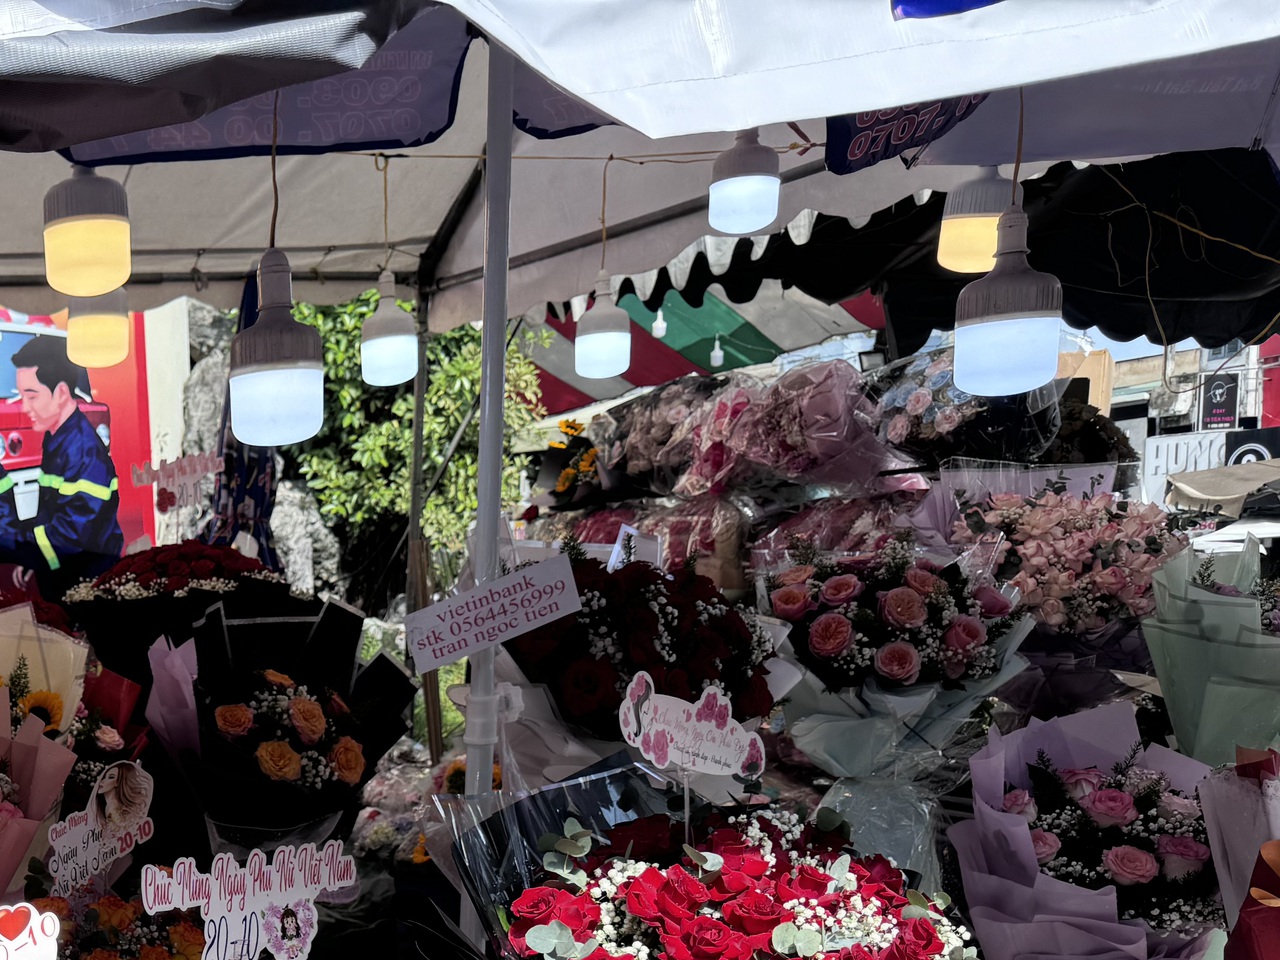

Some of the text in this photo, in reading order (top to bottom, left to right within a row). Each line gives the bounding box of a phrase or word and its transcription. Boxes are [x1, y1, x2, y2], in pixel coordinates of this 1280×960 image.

[847, 102, 945, 161] 0707.
[415, 579, 566, 652] stk 0564456999
[436, 574, 536, 624] vietinbank
[431, 600, 560, 660] tran ngoc tien
[51, 845, 78, 874] Ngày
[116, 820, 152, 852] 20-10
[145, 866, 173, 911] Chúc
[176, 861, 213, 917] Mừng
[213, 856, 247, 913] Ngày
[249, 852, 273, 898] Phụ
[298, 845, 324, 891] Việt
[324, 843, 354, 886] Nam
